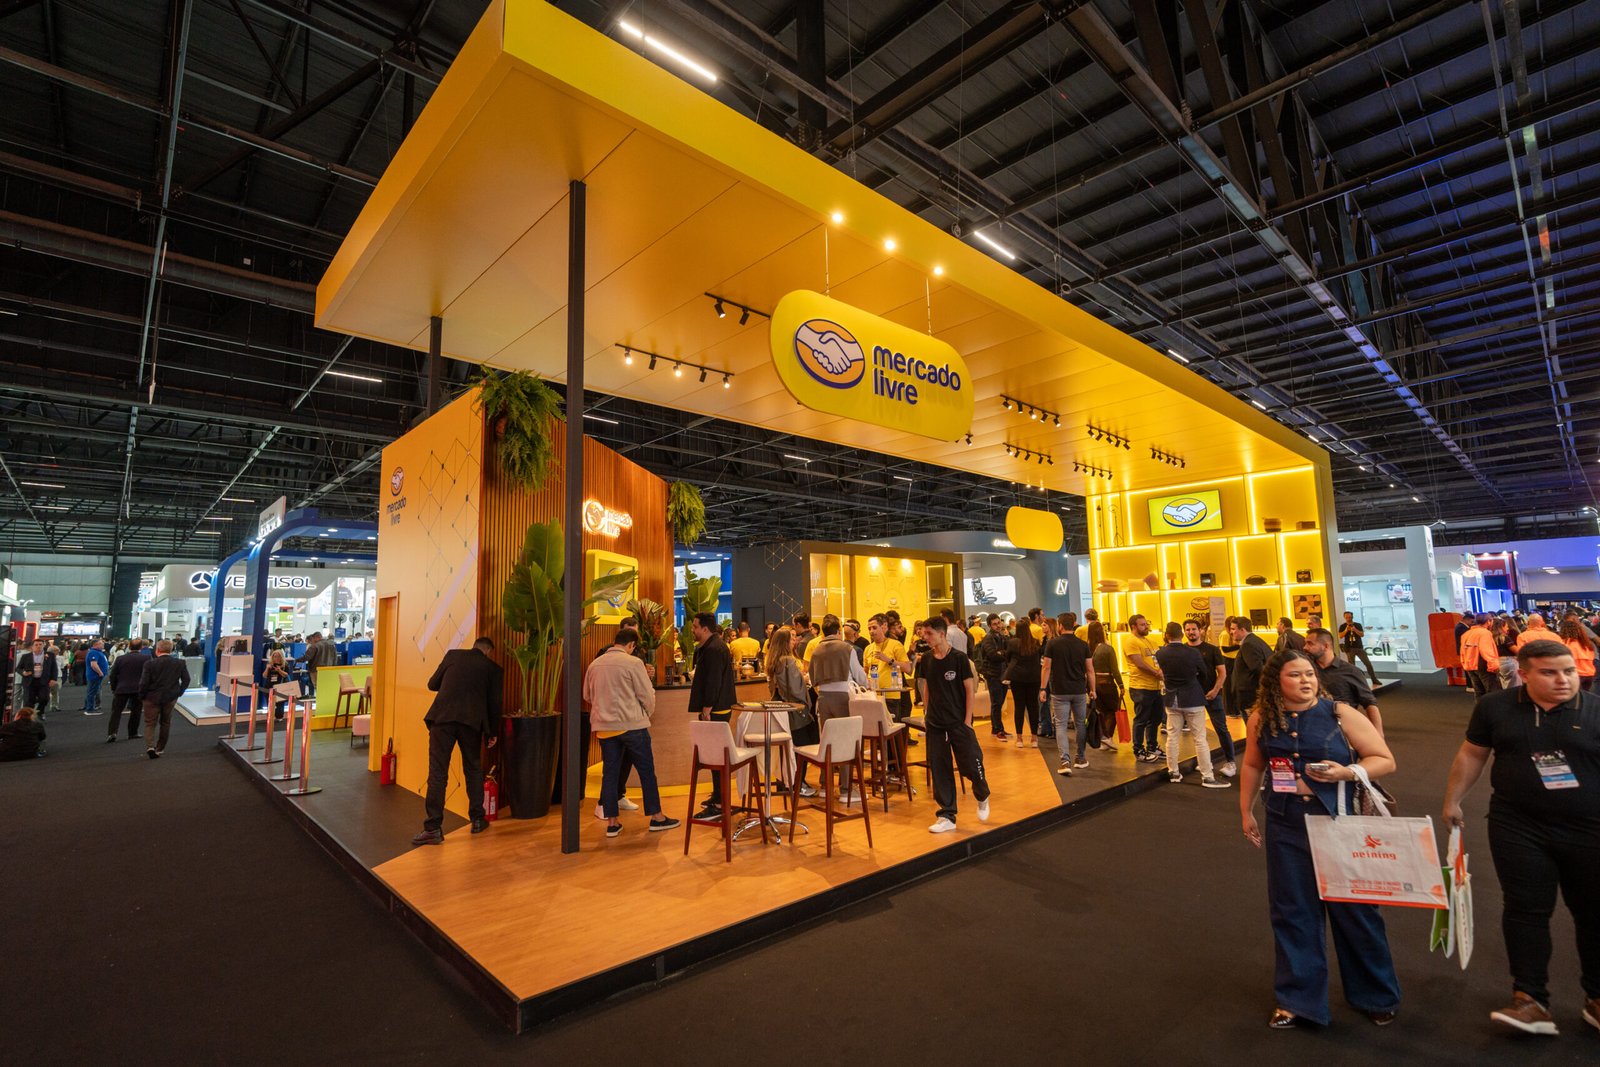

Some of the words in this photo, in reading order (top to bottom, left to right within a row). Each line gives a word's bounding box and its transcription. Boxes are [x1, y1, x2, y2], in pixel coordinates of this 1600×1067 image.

[873, 345, 961, 391] mercado
[873, 368, 918, 405] livre
[386, 496, 406, 514] mercado
[391, 513, 401, 526] livre
[224, 576, 316, 588] VETISOL
